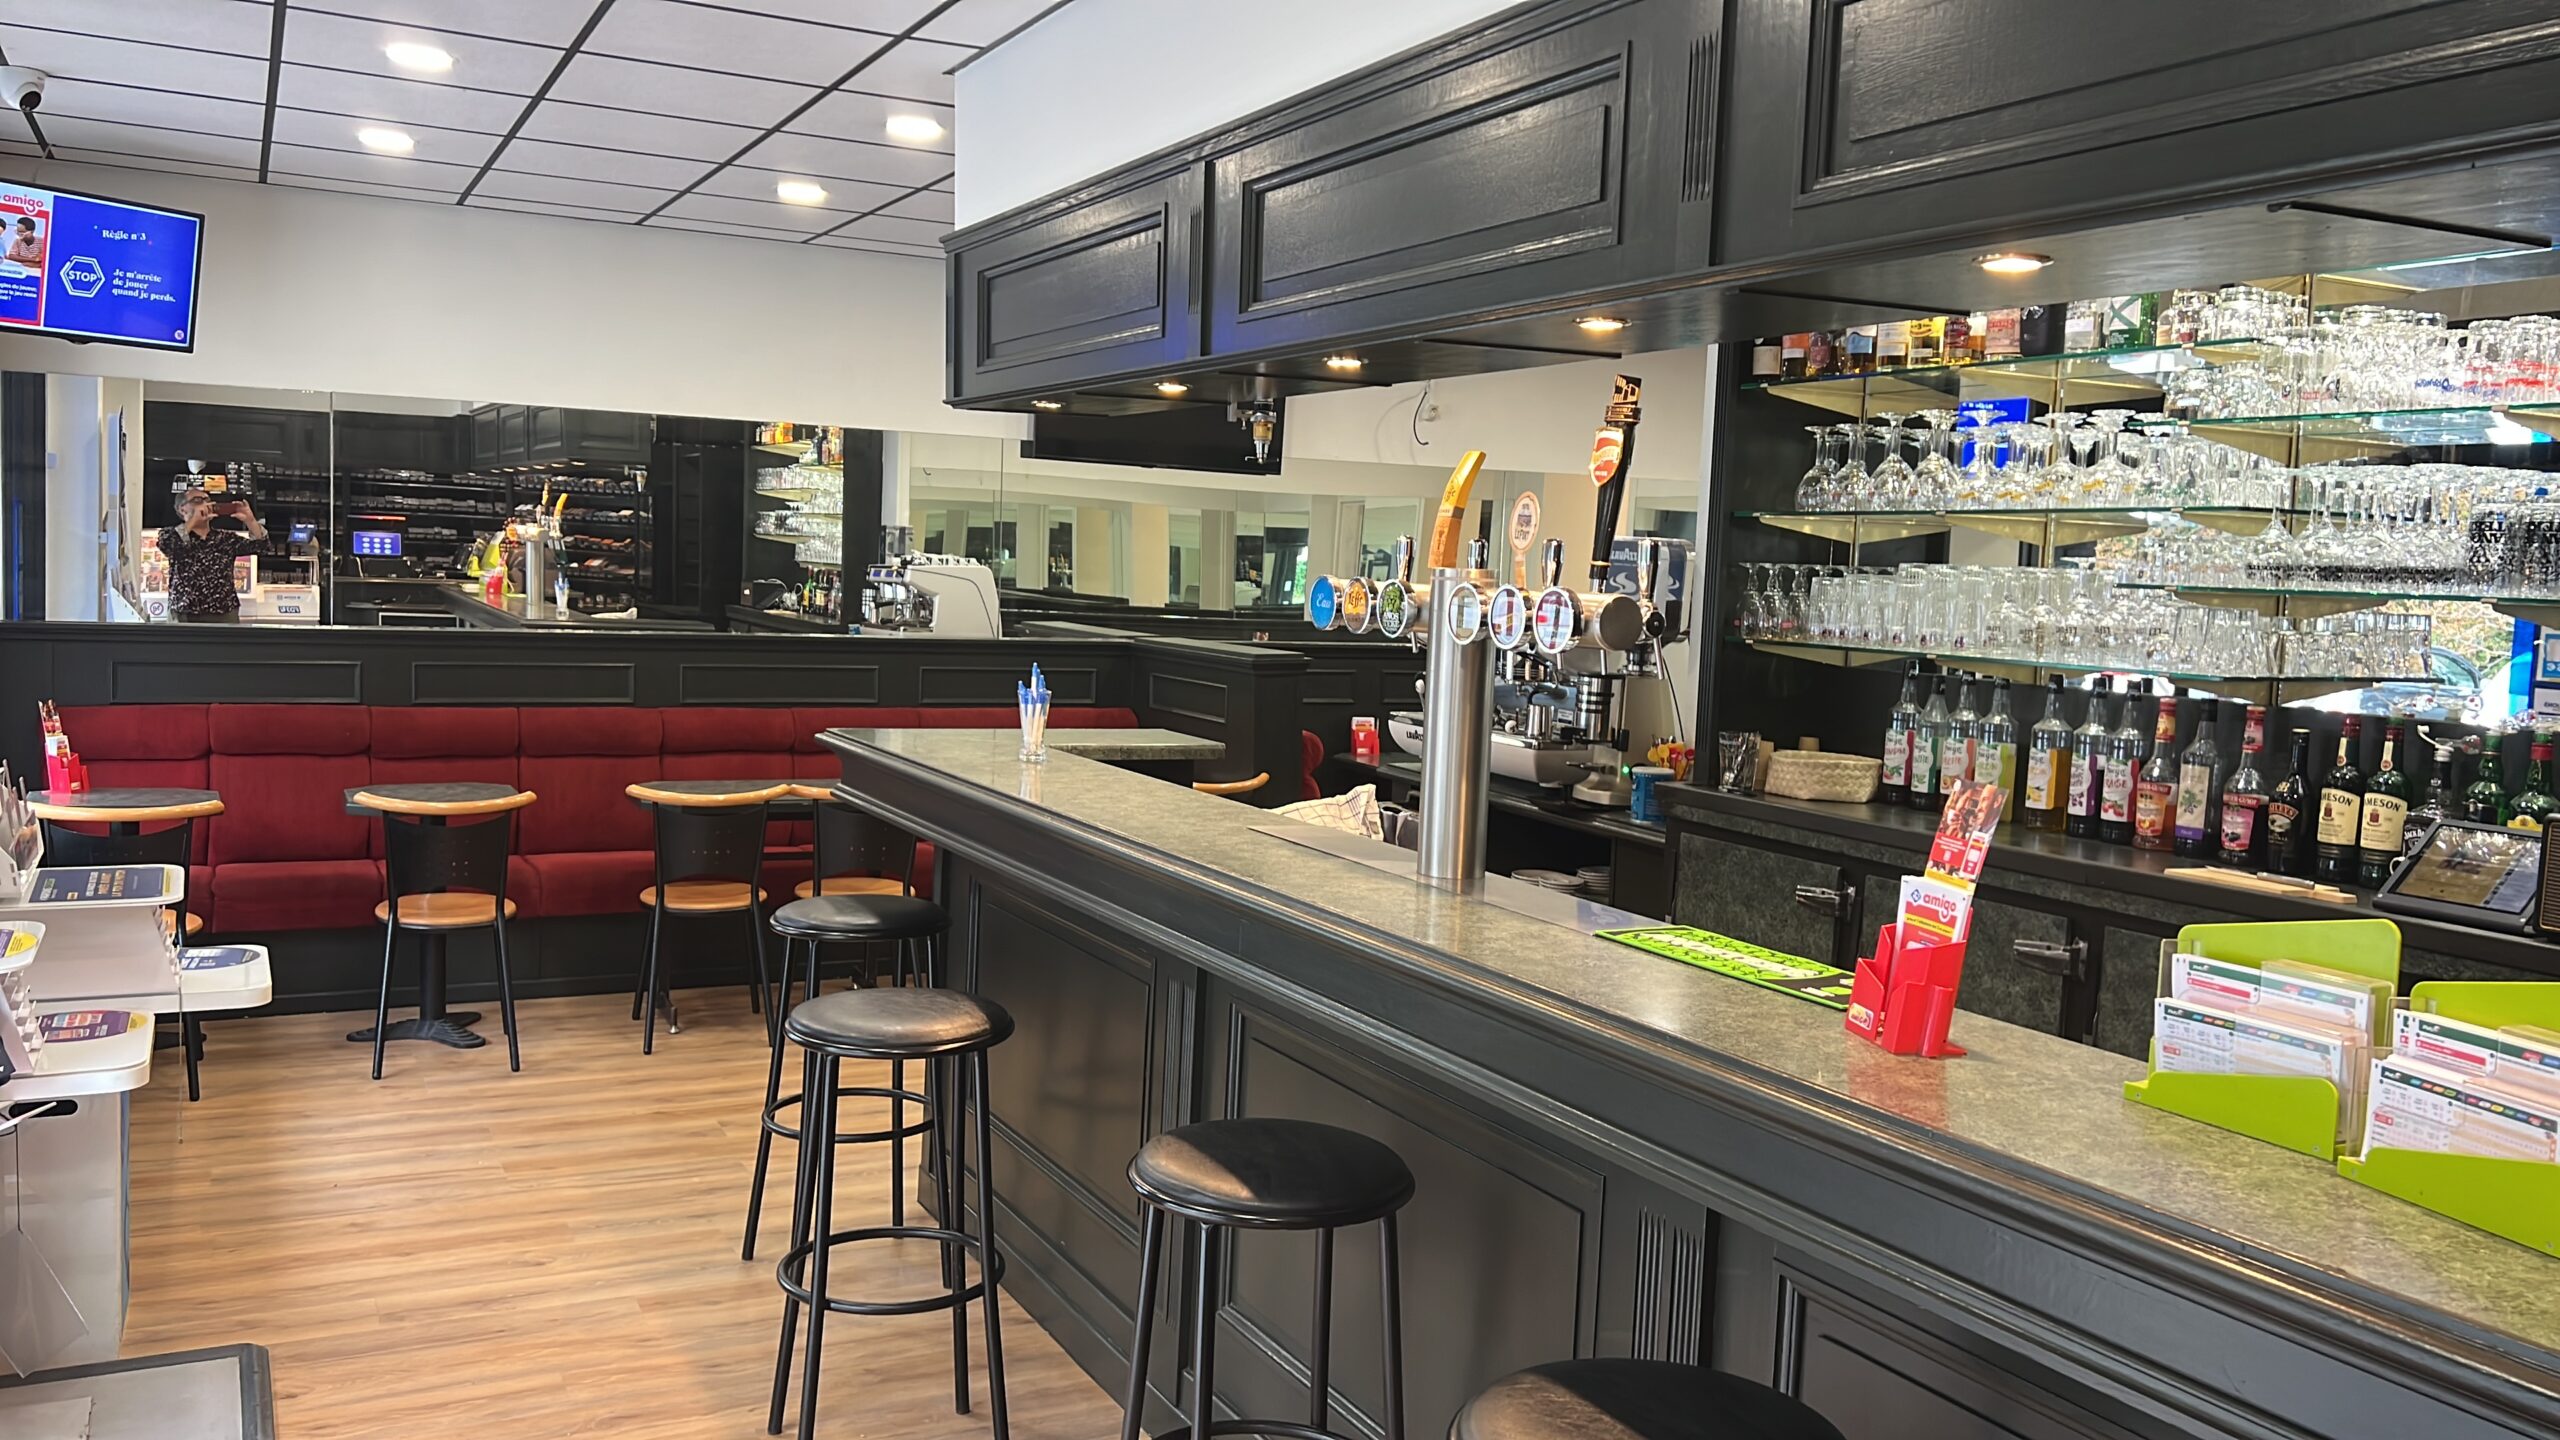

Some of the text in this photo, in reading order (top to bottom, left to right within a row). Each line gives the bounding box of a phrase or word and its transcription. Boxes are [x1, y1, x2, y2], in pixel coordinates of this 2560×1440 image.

[3, 193, 44, 213] amigo
[102, 229, 129, 240] Règle
[68, 270, 98, 282] STOP
[112, 288, 139, 297] quand
[1316, 593, 1331, 608] Eau
[1923, 894, 1957, 919] amigo
